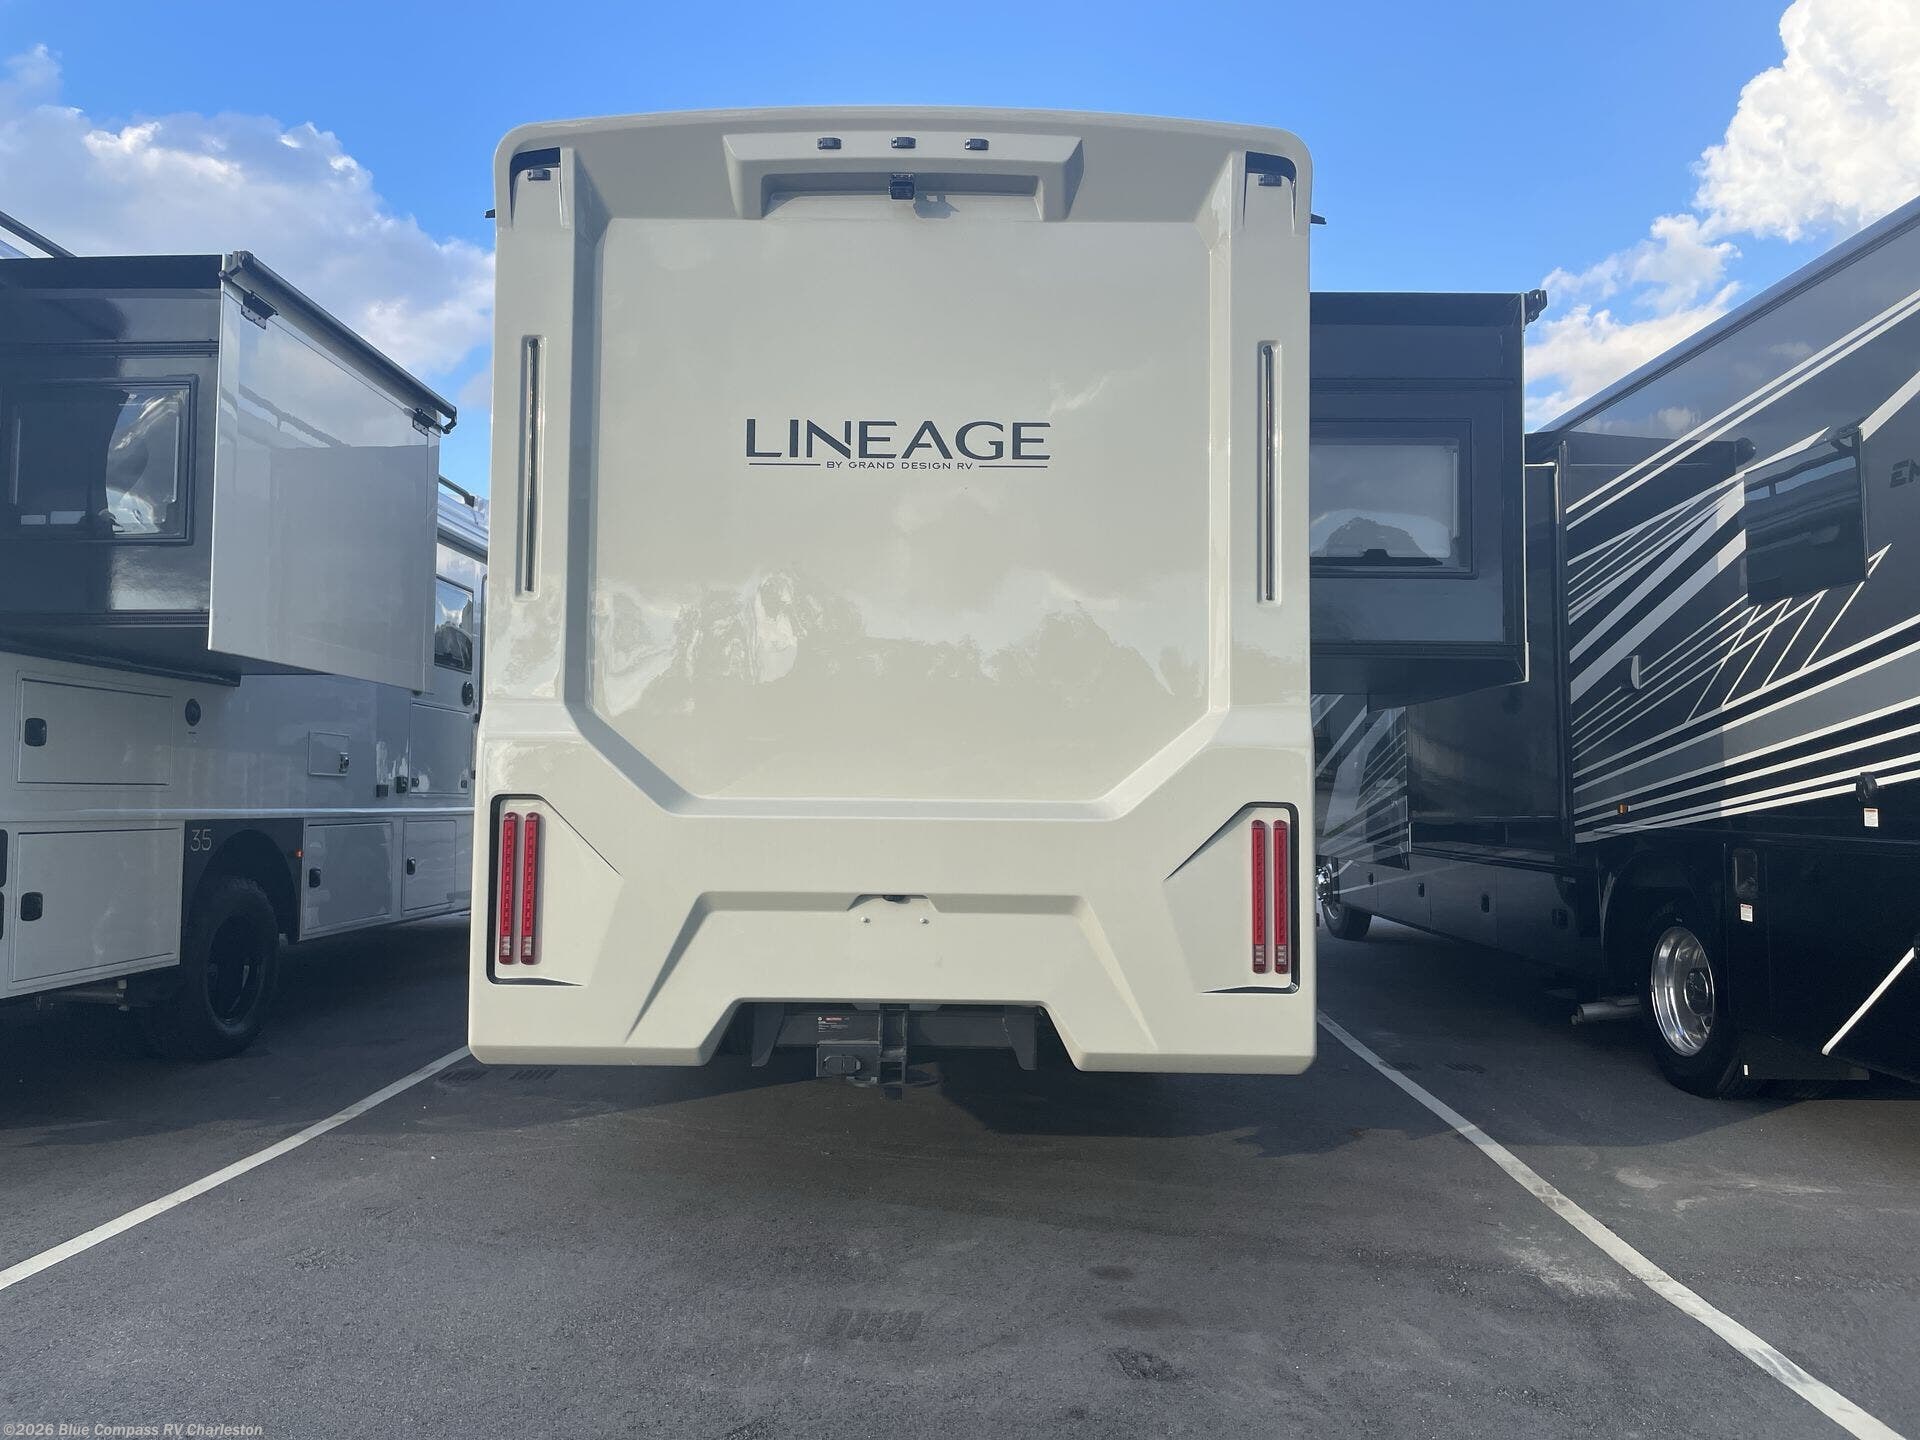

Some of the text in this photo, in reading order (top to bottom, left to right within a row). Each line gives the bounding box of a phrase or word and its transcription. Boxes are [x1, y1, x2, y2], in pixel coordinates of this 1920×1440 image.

[746, 418, 1051, 460] LINEAGE
[826, 461, 973, 470] BY GRAND DESIGN RV
[190, 829, 212, 851] 35
